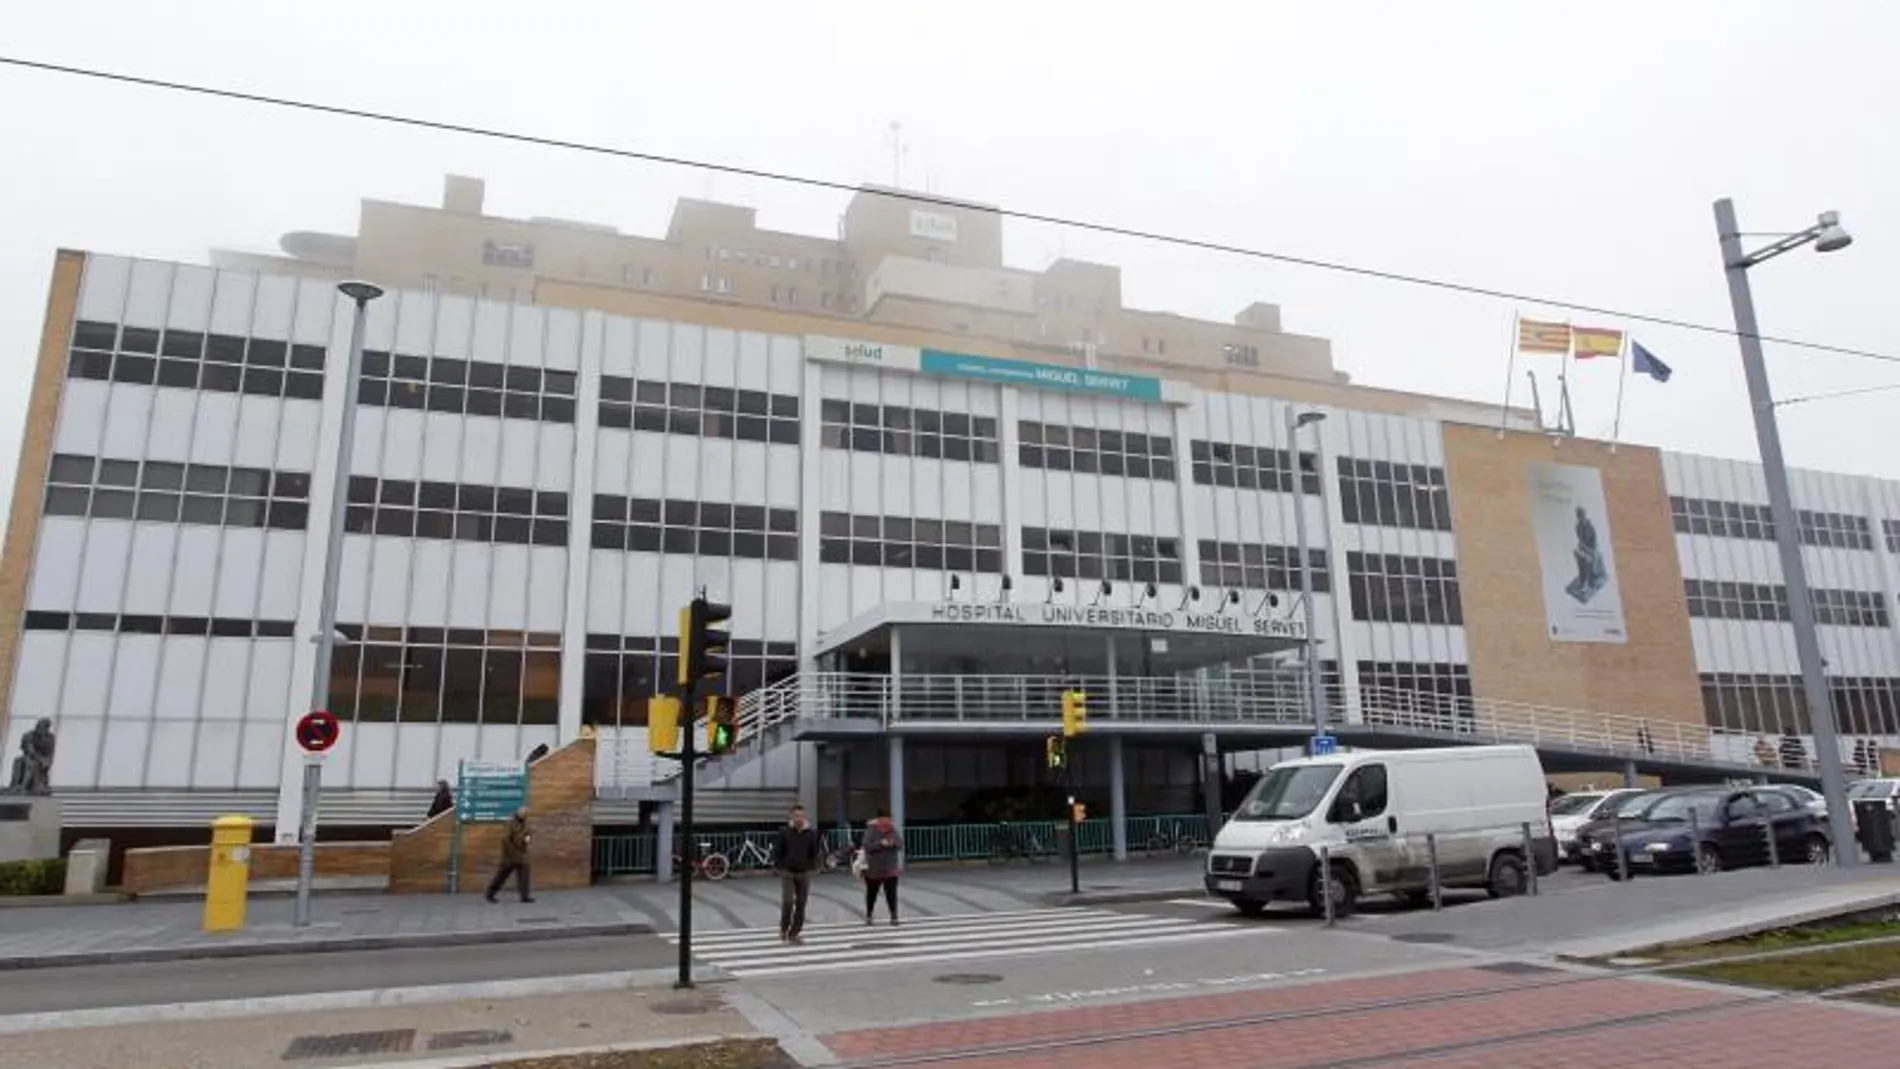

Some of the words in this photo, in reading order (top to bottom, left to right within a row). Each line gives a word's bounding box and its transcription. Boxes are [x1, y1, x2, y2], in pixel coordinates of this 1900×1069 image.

[931, 604, 1026, 622] HOSPITAL
[1042, 606, 1175, 628] UNIVERSITARIO
[1186, 615, 1243, 633] MIGUEL
